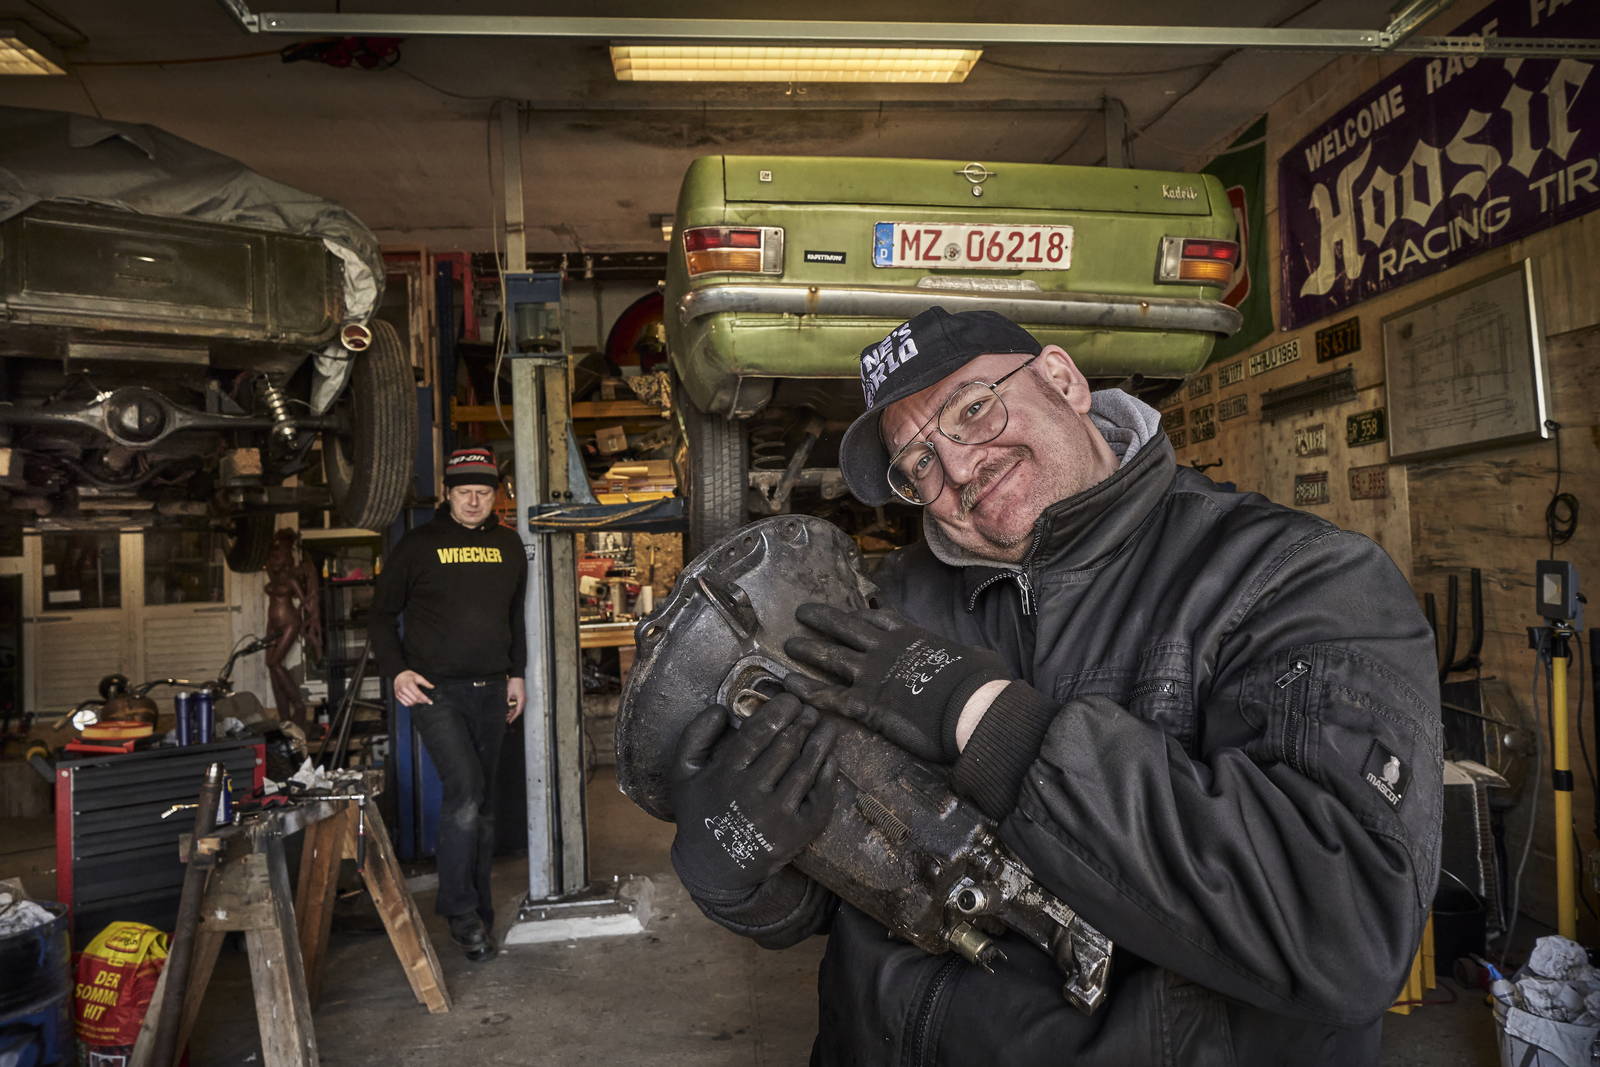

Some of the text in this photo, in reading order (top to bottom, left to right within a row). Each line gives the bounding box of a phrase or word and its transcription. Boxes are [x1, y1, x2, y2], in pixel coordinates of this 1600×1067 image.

[1305, 84, 1405, 172] WELCOME
[900, 229, 1065, 263] MZ 06218
[1378, 196, 1511, 281] RACING
[880, 249, 888, 258] D
[437, 546, 502, 564] WRECKER
[1366, 772, 1399, 805] MASCOT
[94, 970, 122, 988] DER
[83, 1003, 106, 1021] HIT
